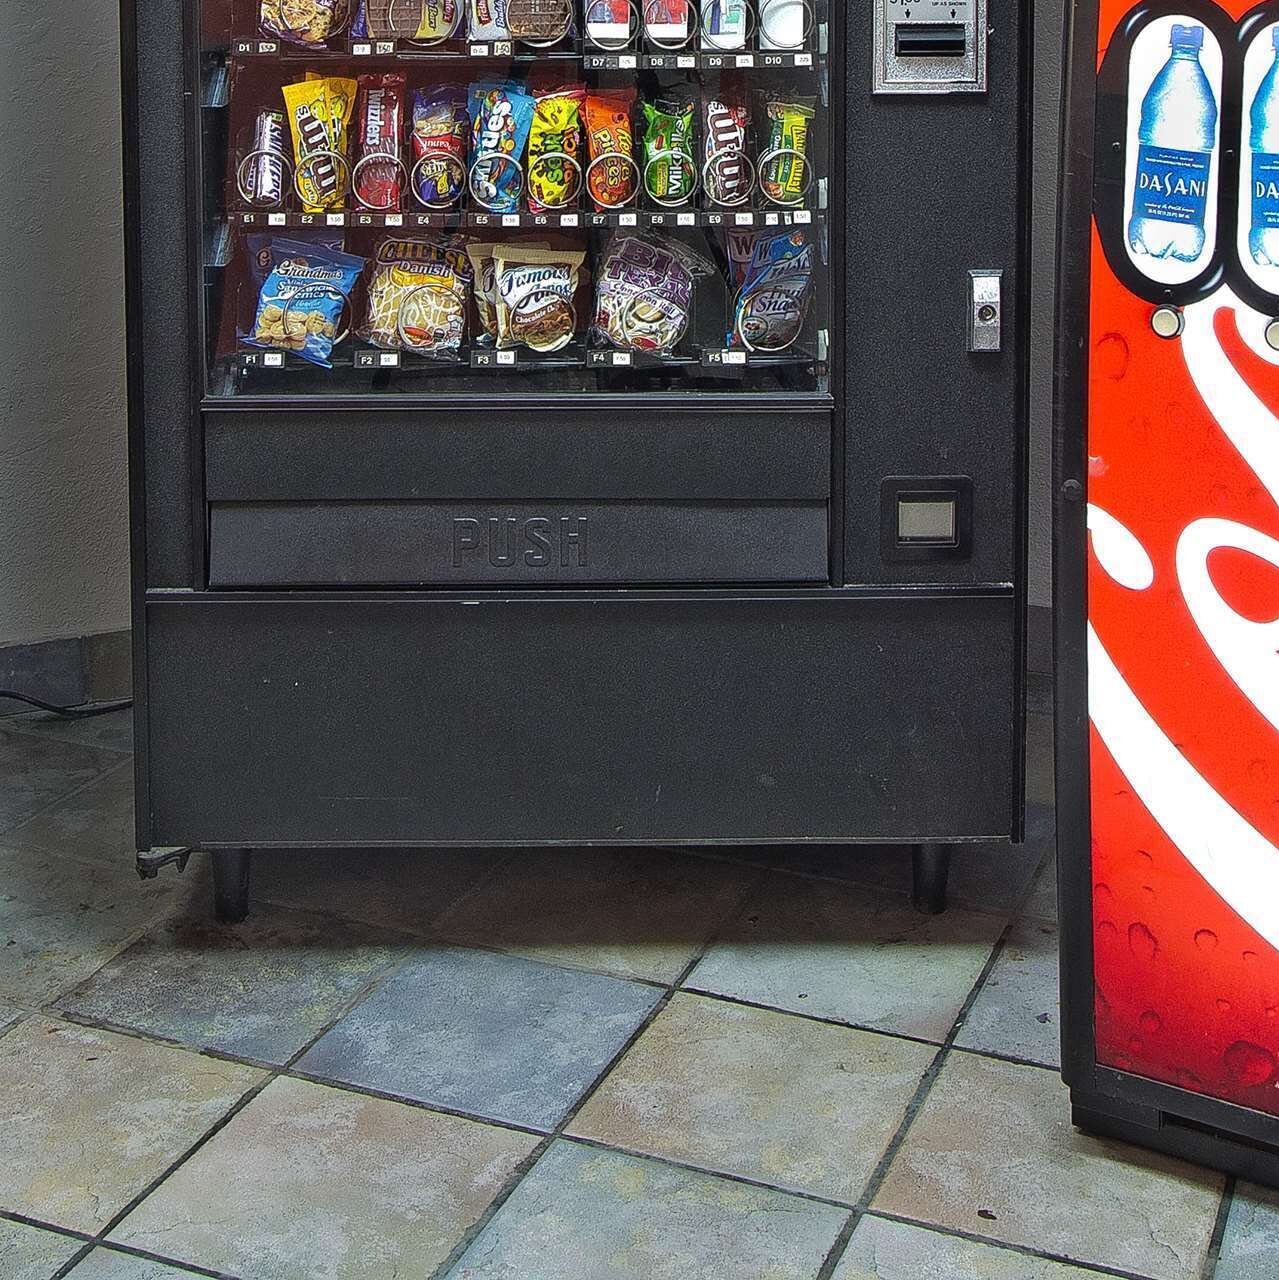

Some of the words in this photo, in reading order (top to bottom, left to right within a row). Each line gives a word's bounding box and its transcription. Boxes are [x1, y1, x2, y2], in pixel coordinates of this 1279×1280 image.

[239, 43, 251, 52] D1
[593, 58, 605, 67] D7
[651, 57, 663, 66] D8
[709, 57, 722, 66] D9
[765, 56, 782, 65] D10
[1139, 172, 1207, 197] DASANI
[244, 215, 254, 223] E1
[360, 216, 371, 224] E3
[418, 216, 429, 224] E4
[476, 216, 488, 224] E5
[535, 216, 547, 224] E6
[593, 216, 605, 224] E7
[651, 216, 664, 224] E8
[709, 216, 721, 224] E9
[399, 260, 450, 277] Danish
[245, 356, 256, 364] F1
[361, 357, 373, 365] F2
[478, 356, 489, 364] F3
[593, 355, 605, 363] F4
[709, 354, 721, 363] F5
[452, 517, 588, 568] PUSH
